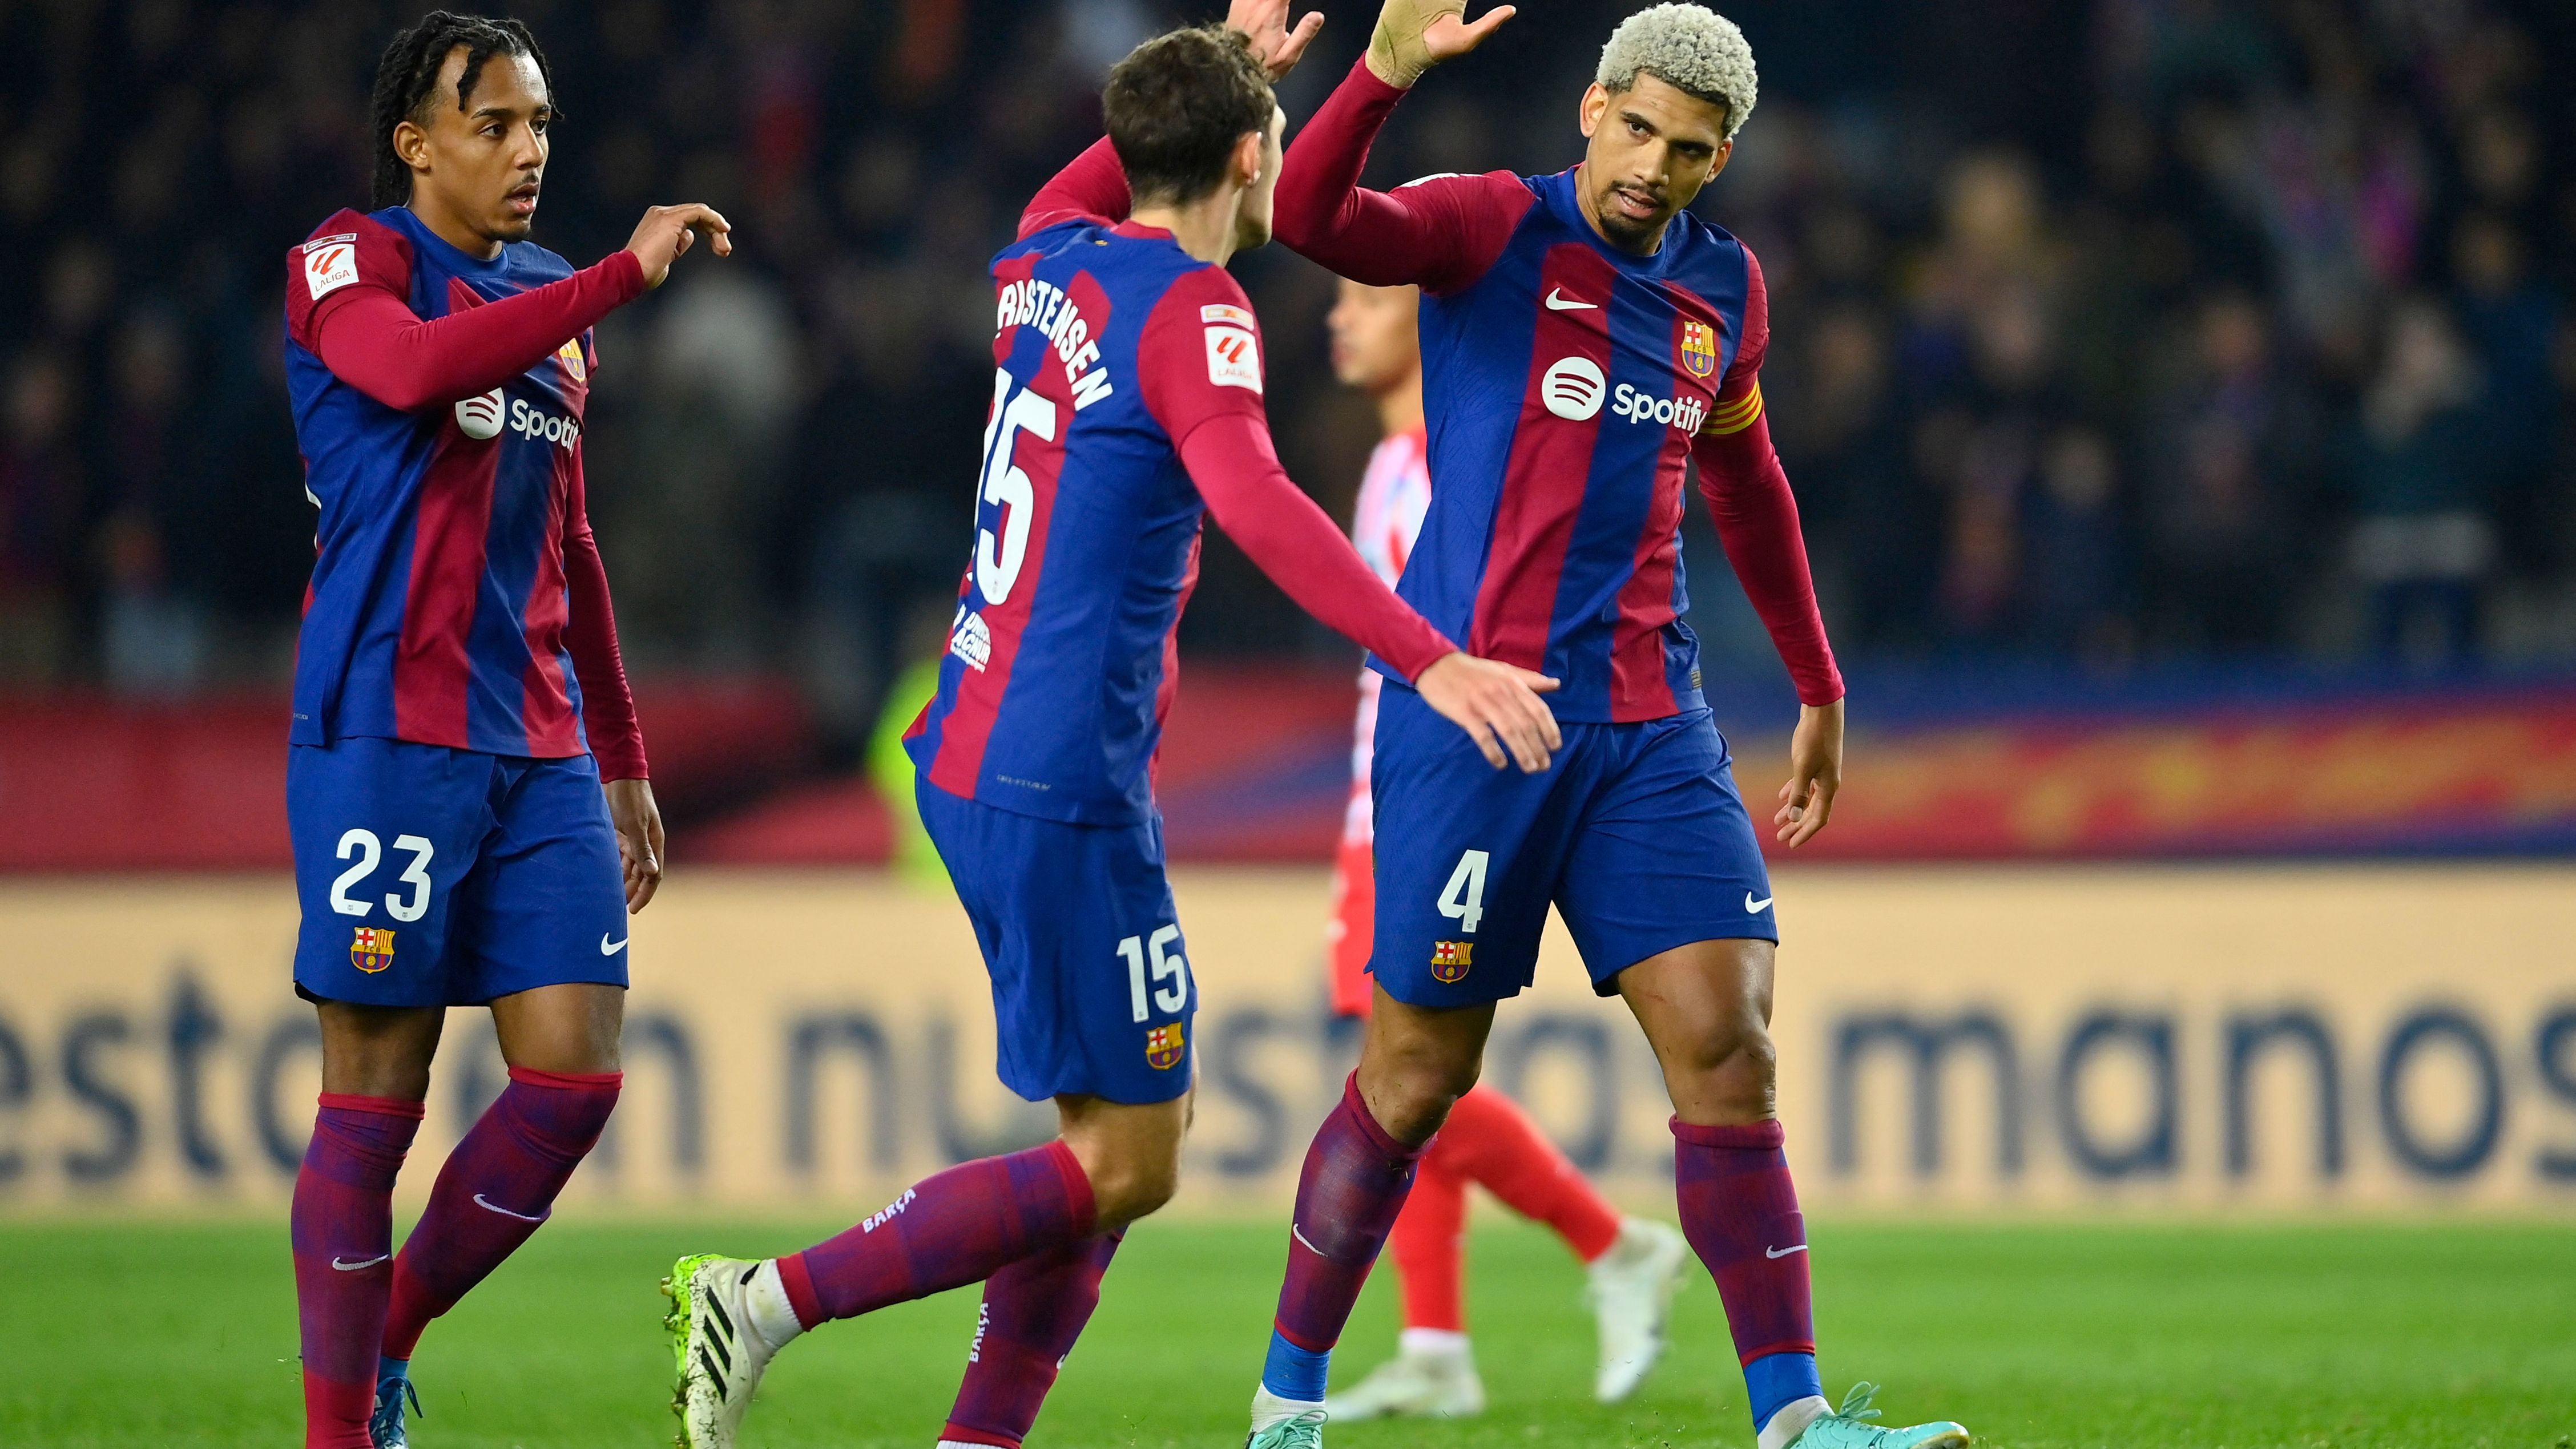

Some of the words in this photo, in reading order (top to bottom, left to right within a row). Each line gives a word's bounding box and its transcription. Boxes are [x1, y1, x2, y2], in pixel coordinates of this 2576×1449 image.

[316, 270, 350, 292] LALIGA
[995, 279, 1113, 411] RISTENSEN
[1612, 383, 1707, 438] Spotify
[330, 828, 434, 922] 23
[1437, 849, 1489, 933] 4
[1116, 923, 1187, 1023] 15
[862, 1188, 916, 1233] BARÇA
[969, 1302, 989, 1362] BARÇA
